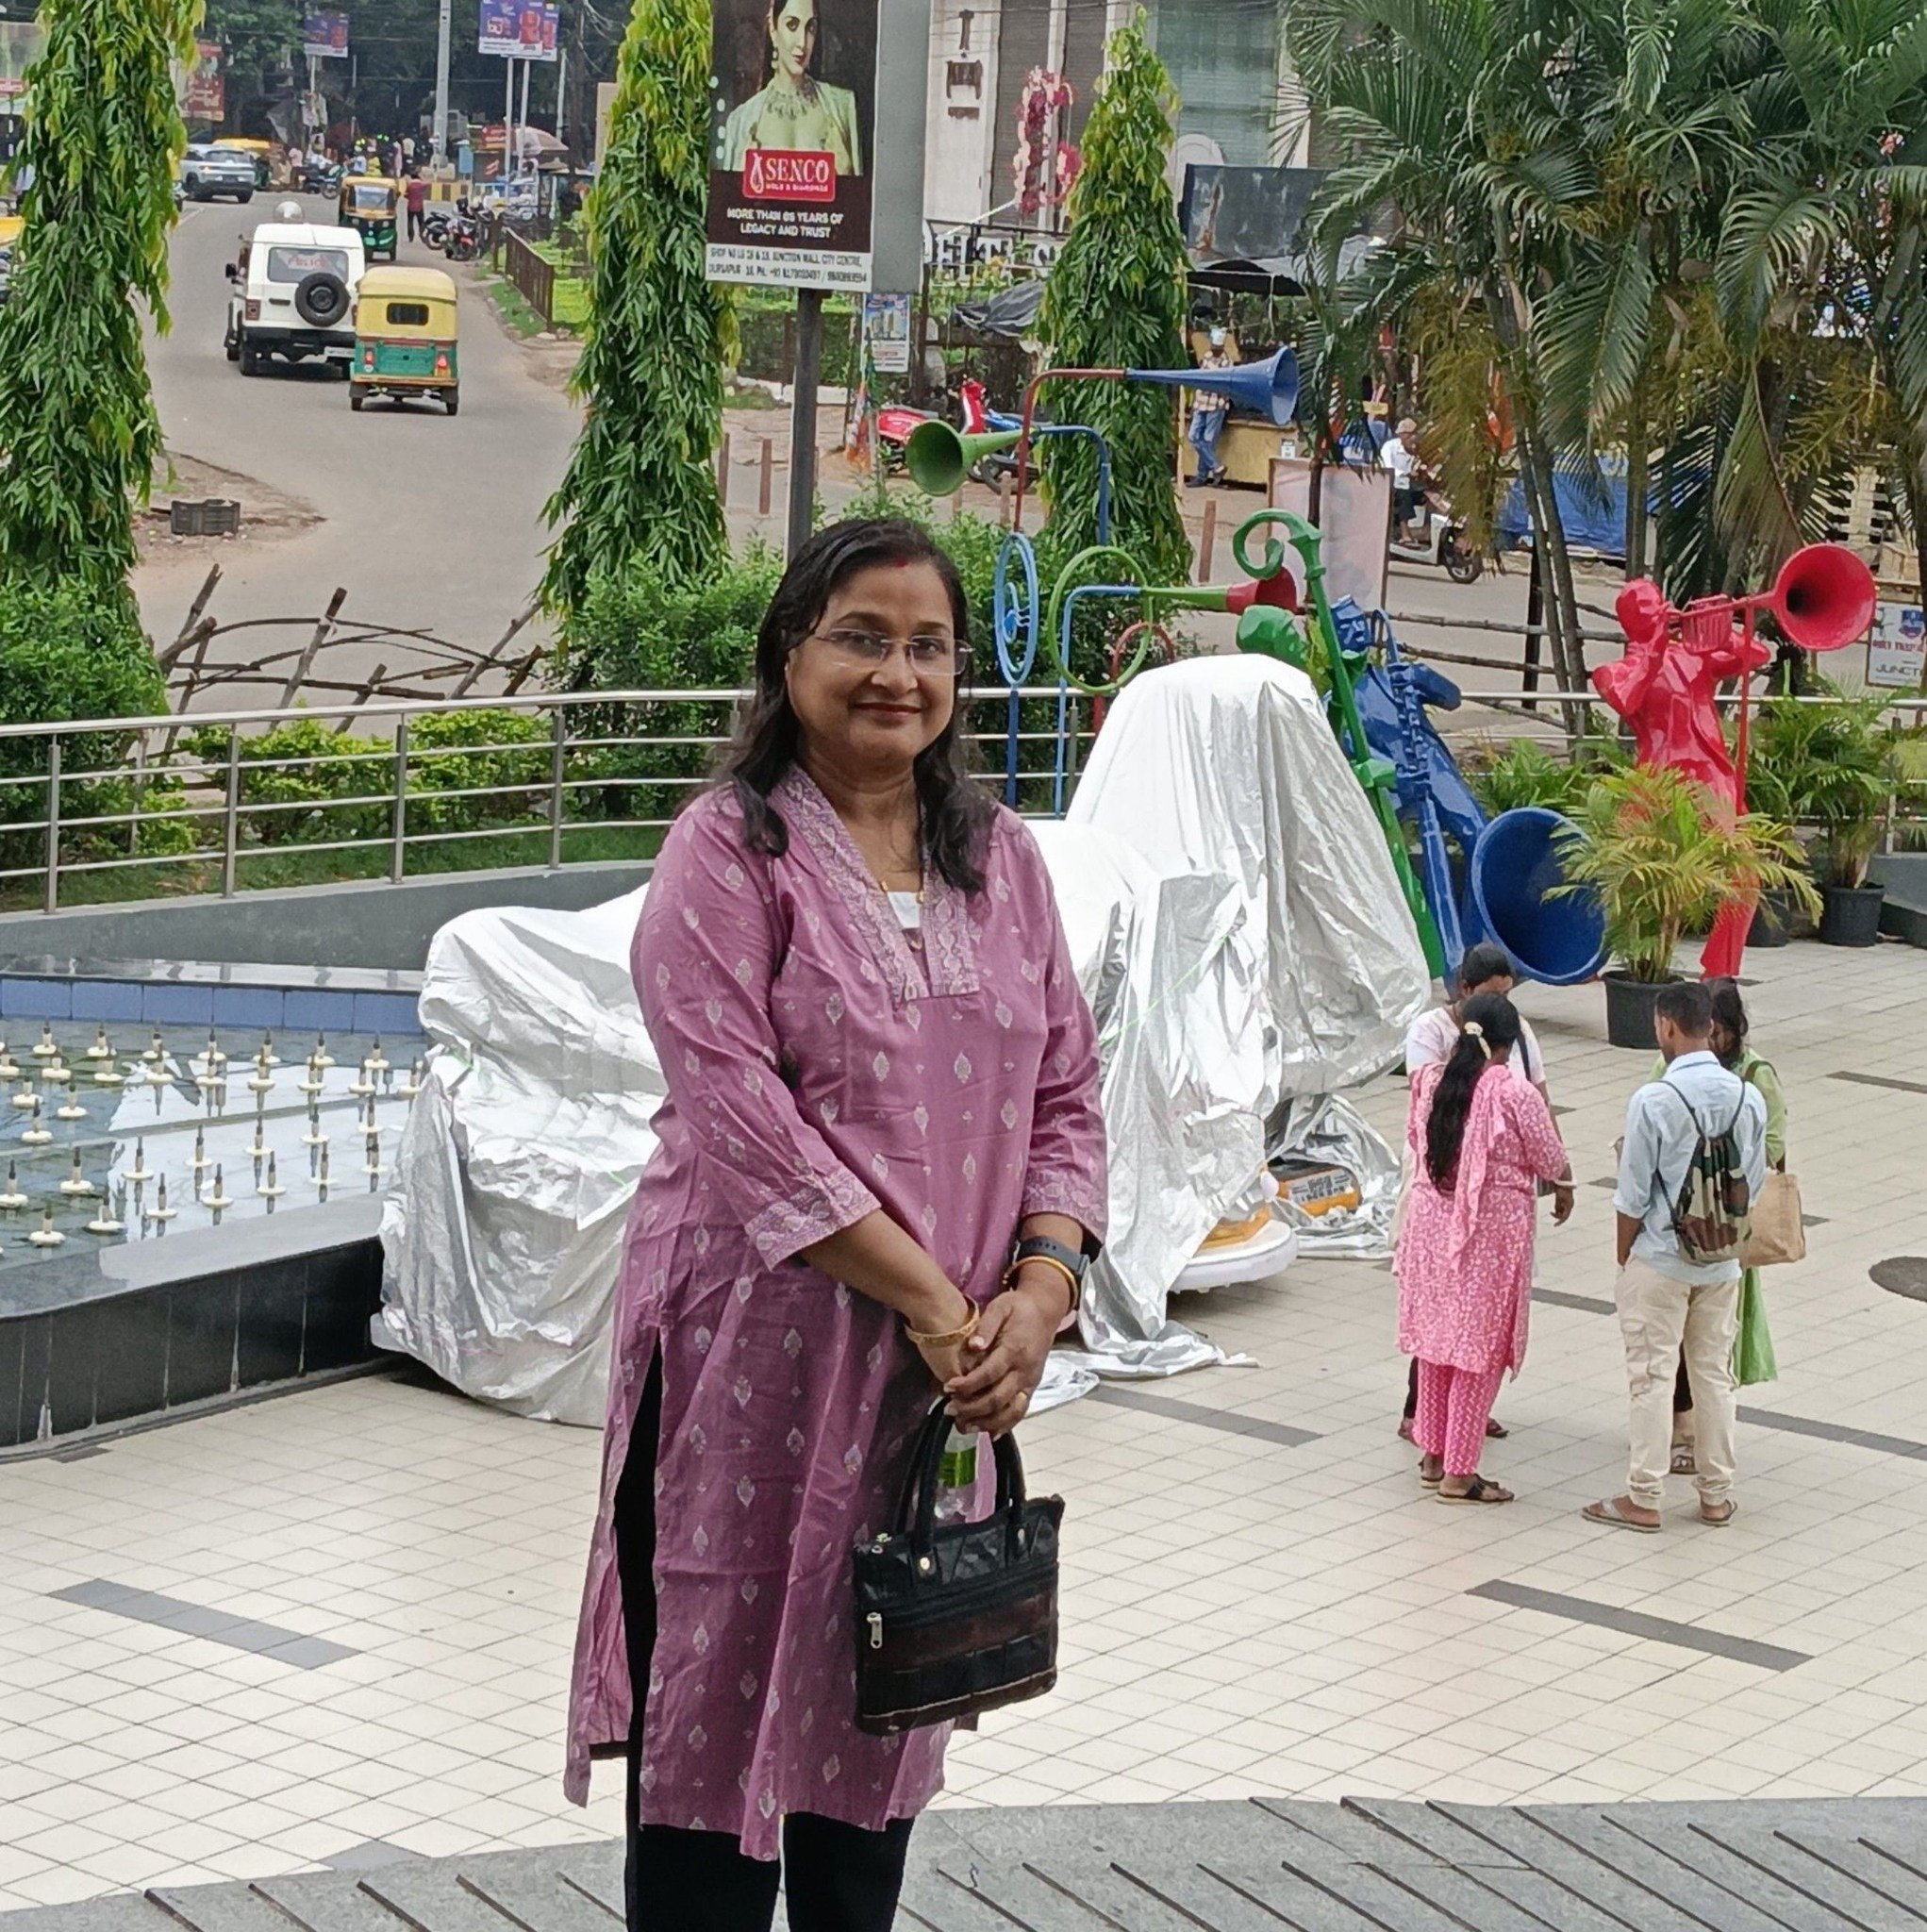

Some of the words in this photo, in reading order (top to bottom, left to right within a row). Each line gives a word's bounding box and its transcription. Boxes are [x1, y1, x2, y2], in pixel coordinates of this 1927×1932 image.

[766, 158, 829, 183] SENCO
[727, 208, 754, 219] MORE
[756, 209, 780, 221] THAN
[797, 211, 829, 224] YEARS
[830, 213, 844, 225] OF
[740, 223, 776, 234] LEGACY
[778, 225, 798, 236] AND
[800, 226, 831, 238] TRUST
